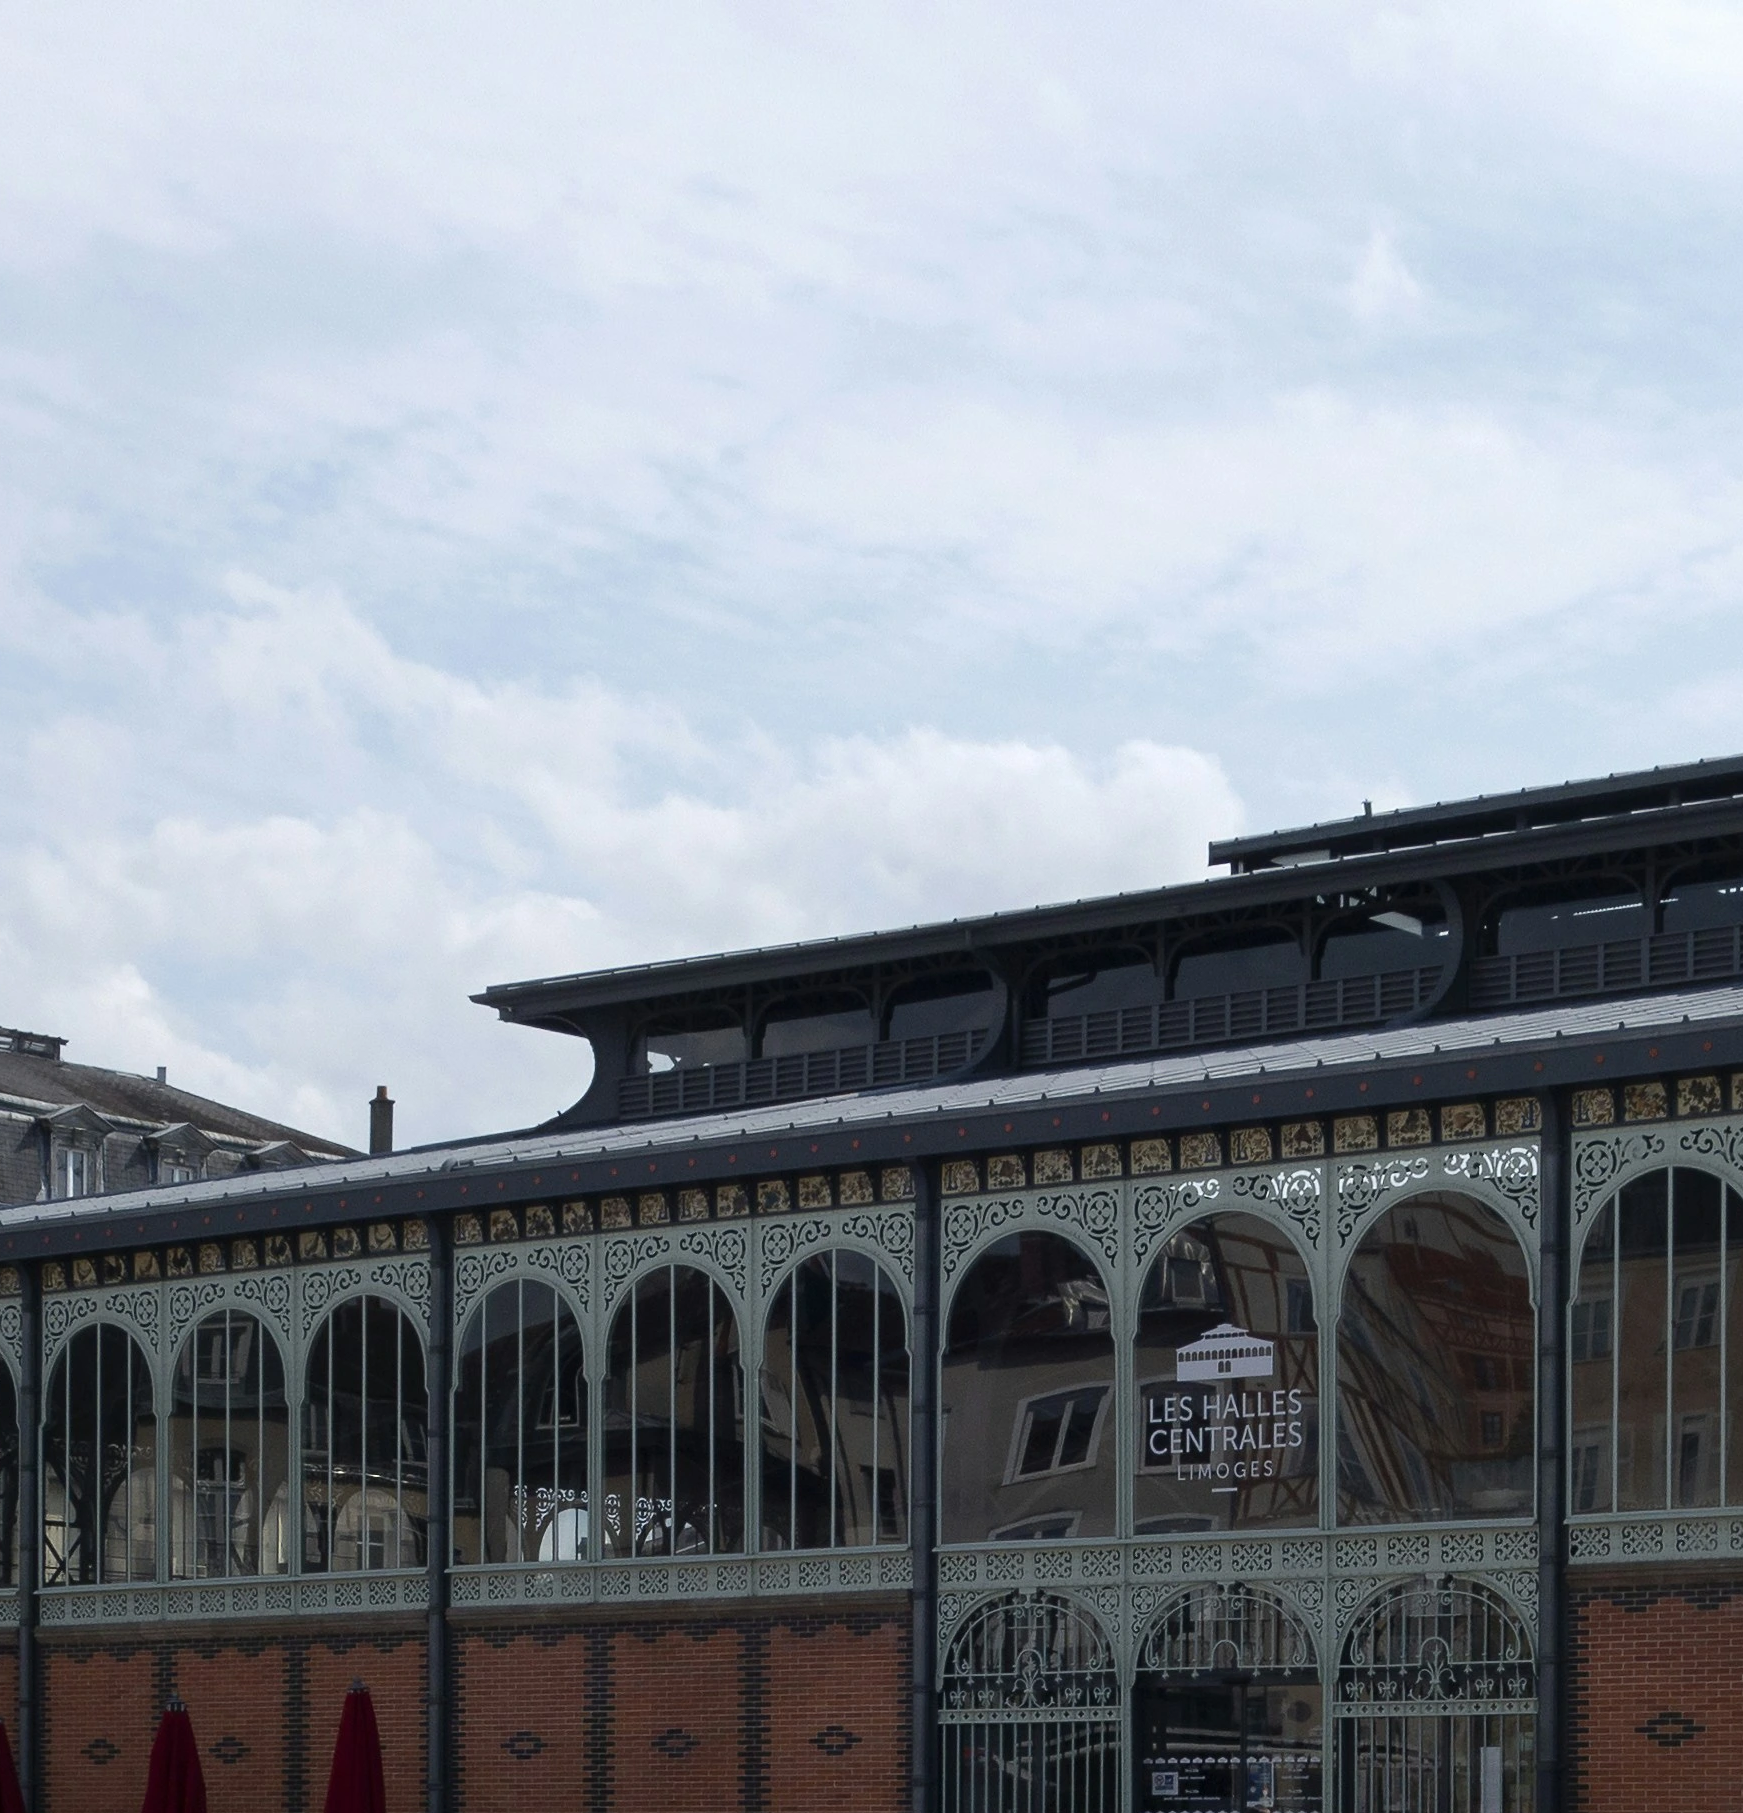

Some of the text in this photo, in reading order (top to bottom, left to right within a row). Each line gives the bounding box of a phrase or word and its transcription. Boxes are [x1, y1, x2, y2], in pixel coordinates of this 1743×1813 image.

[1149, 1389, 1303, 1423] LES HALLES
[1149, 1422, 1303, 1454] CENTRALES
[1177, 1459, 1274, 1481] LIMOGES
